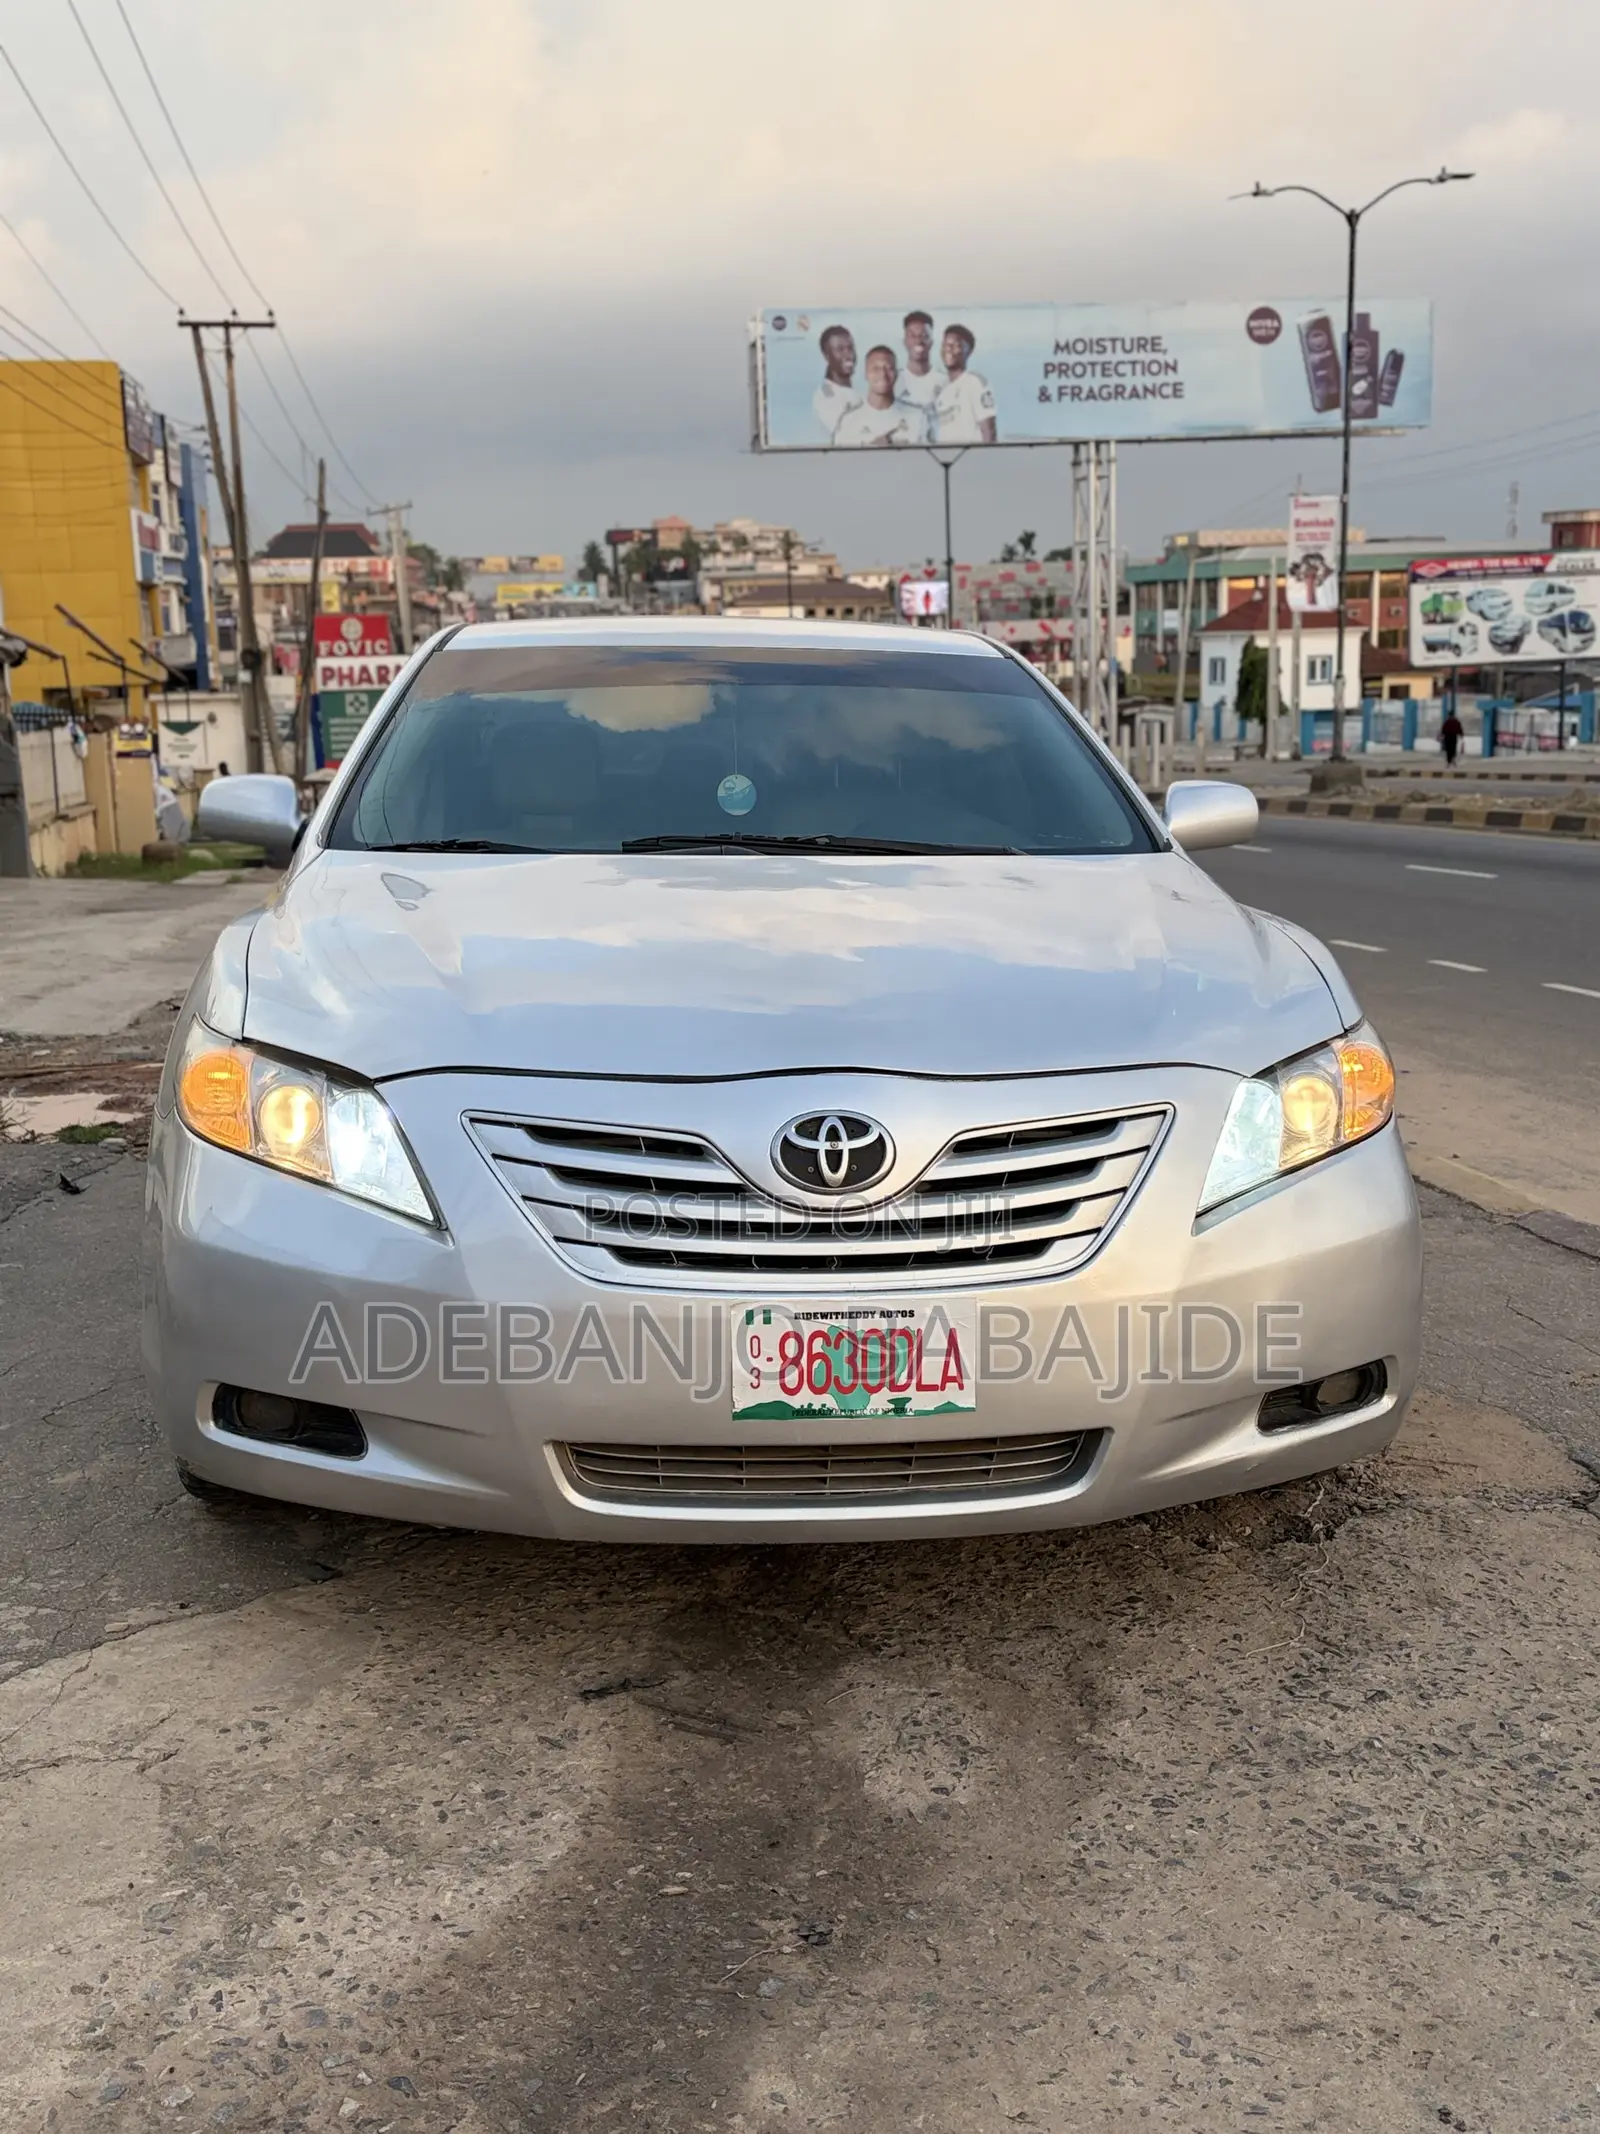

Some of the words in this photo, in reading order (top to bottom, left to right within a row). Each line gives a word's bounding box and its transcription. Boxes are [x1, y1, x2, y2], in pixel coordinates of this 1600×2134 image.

[1053, 336, 1168, 356] MOISTURE,
[1043, 359, 1178, 379] PROTECTION
[1038, 385, 1052, 403] &
[1057, 382, 1184, 402] FRAGRANCE
[794, 1311, 876, 1321] RIDEWITHEDDY
[879, 1310, 915, 1319] AUTOS
